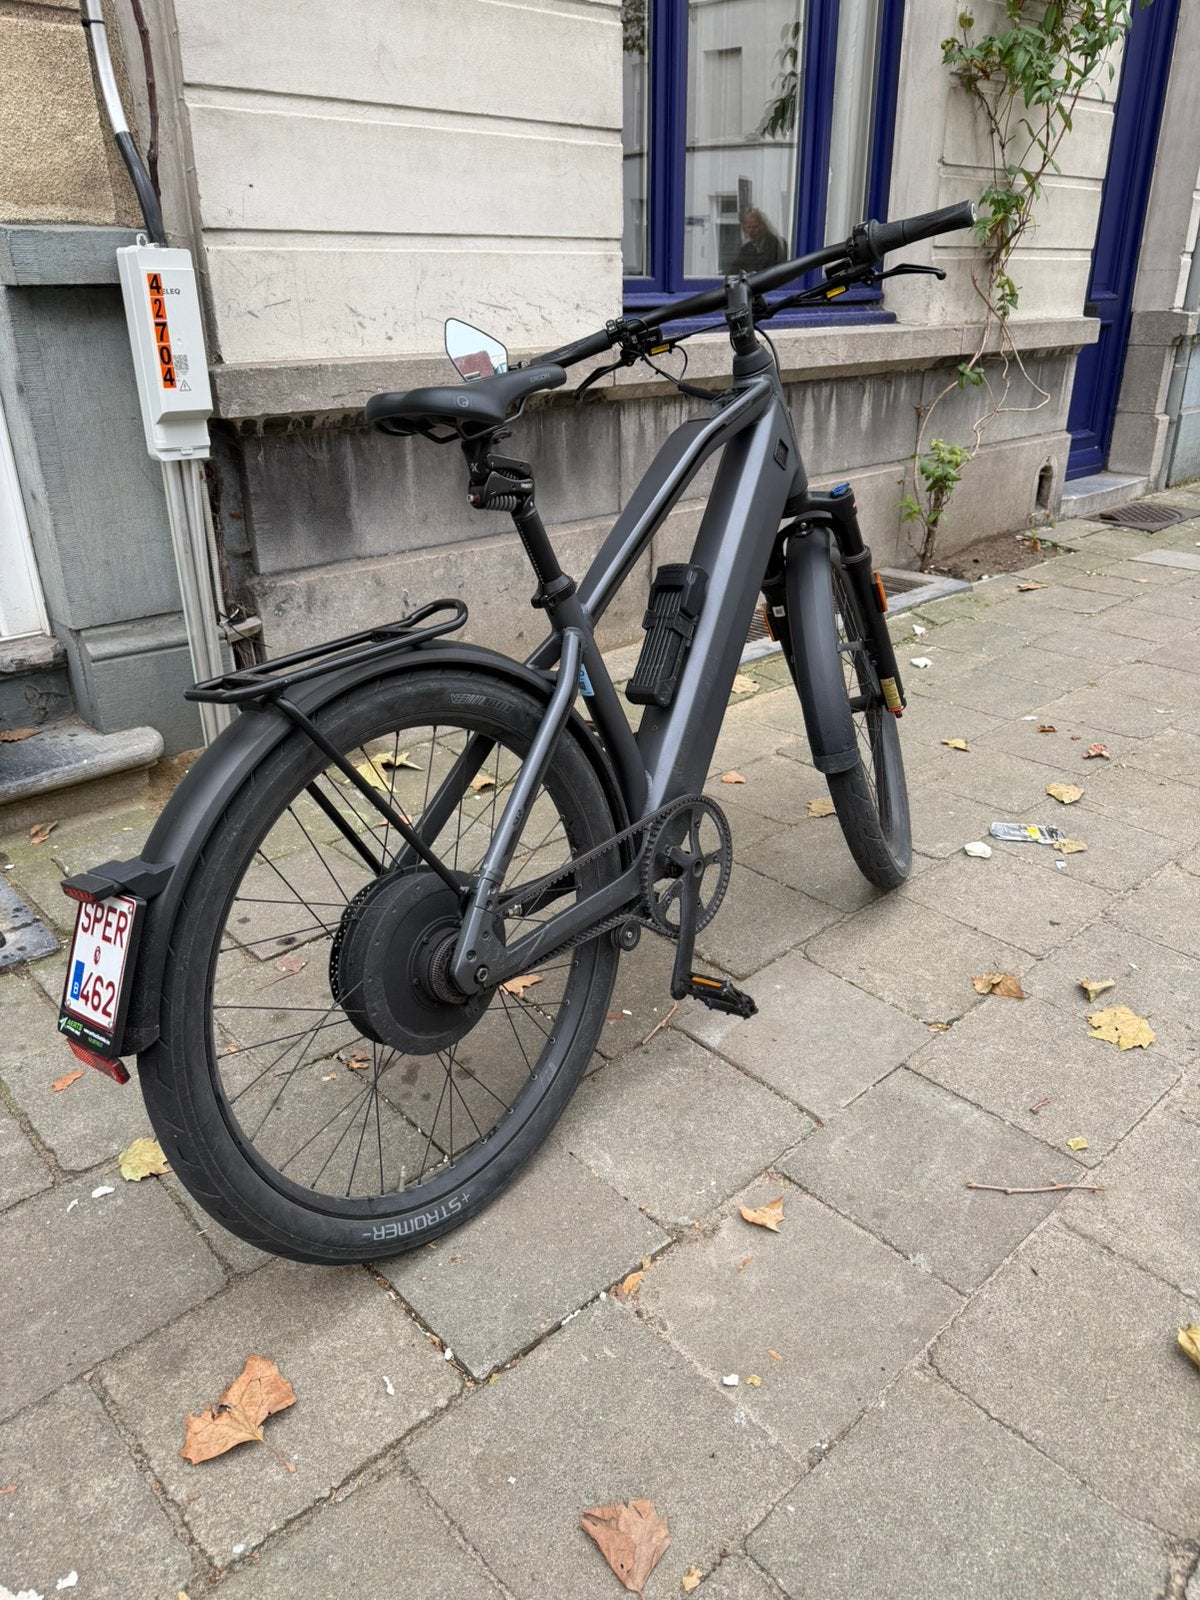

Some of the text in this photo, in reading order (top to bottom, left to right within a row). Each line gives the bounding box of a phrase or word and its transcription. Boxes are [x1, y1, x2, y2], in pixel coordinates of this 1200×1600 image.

[150, 274, 174, 385] 42704
[81, 903, 128, 948] SPER
[73, 987, 79, 995] B
[80, 972, 115, 1018] 462
